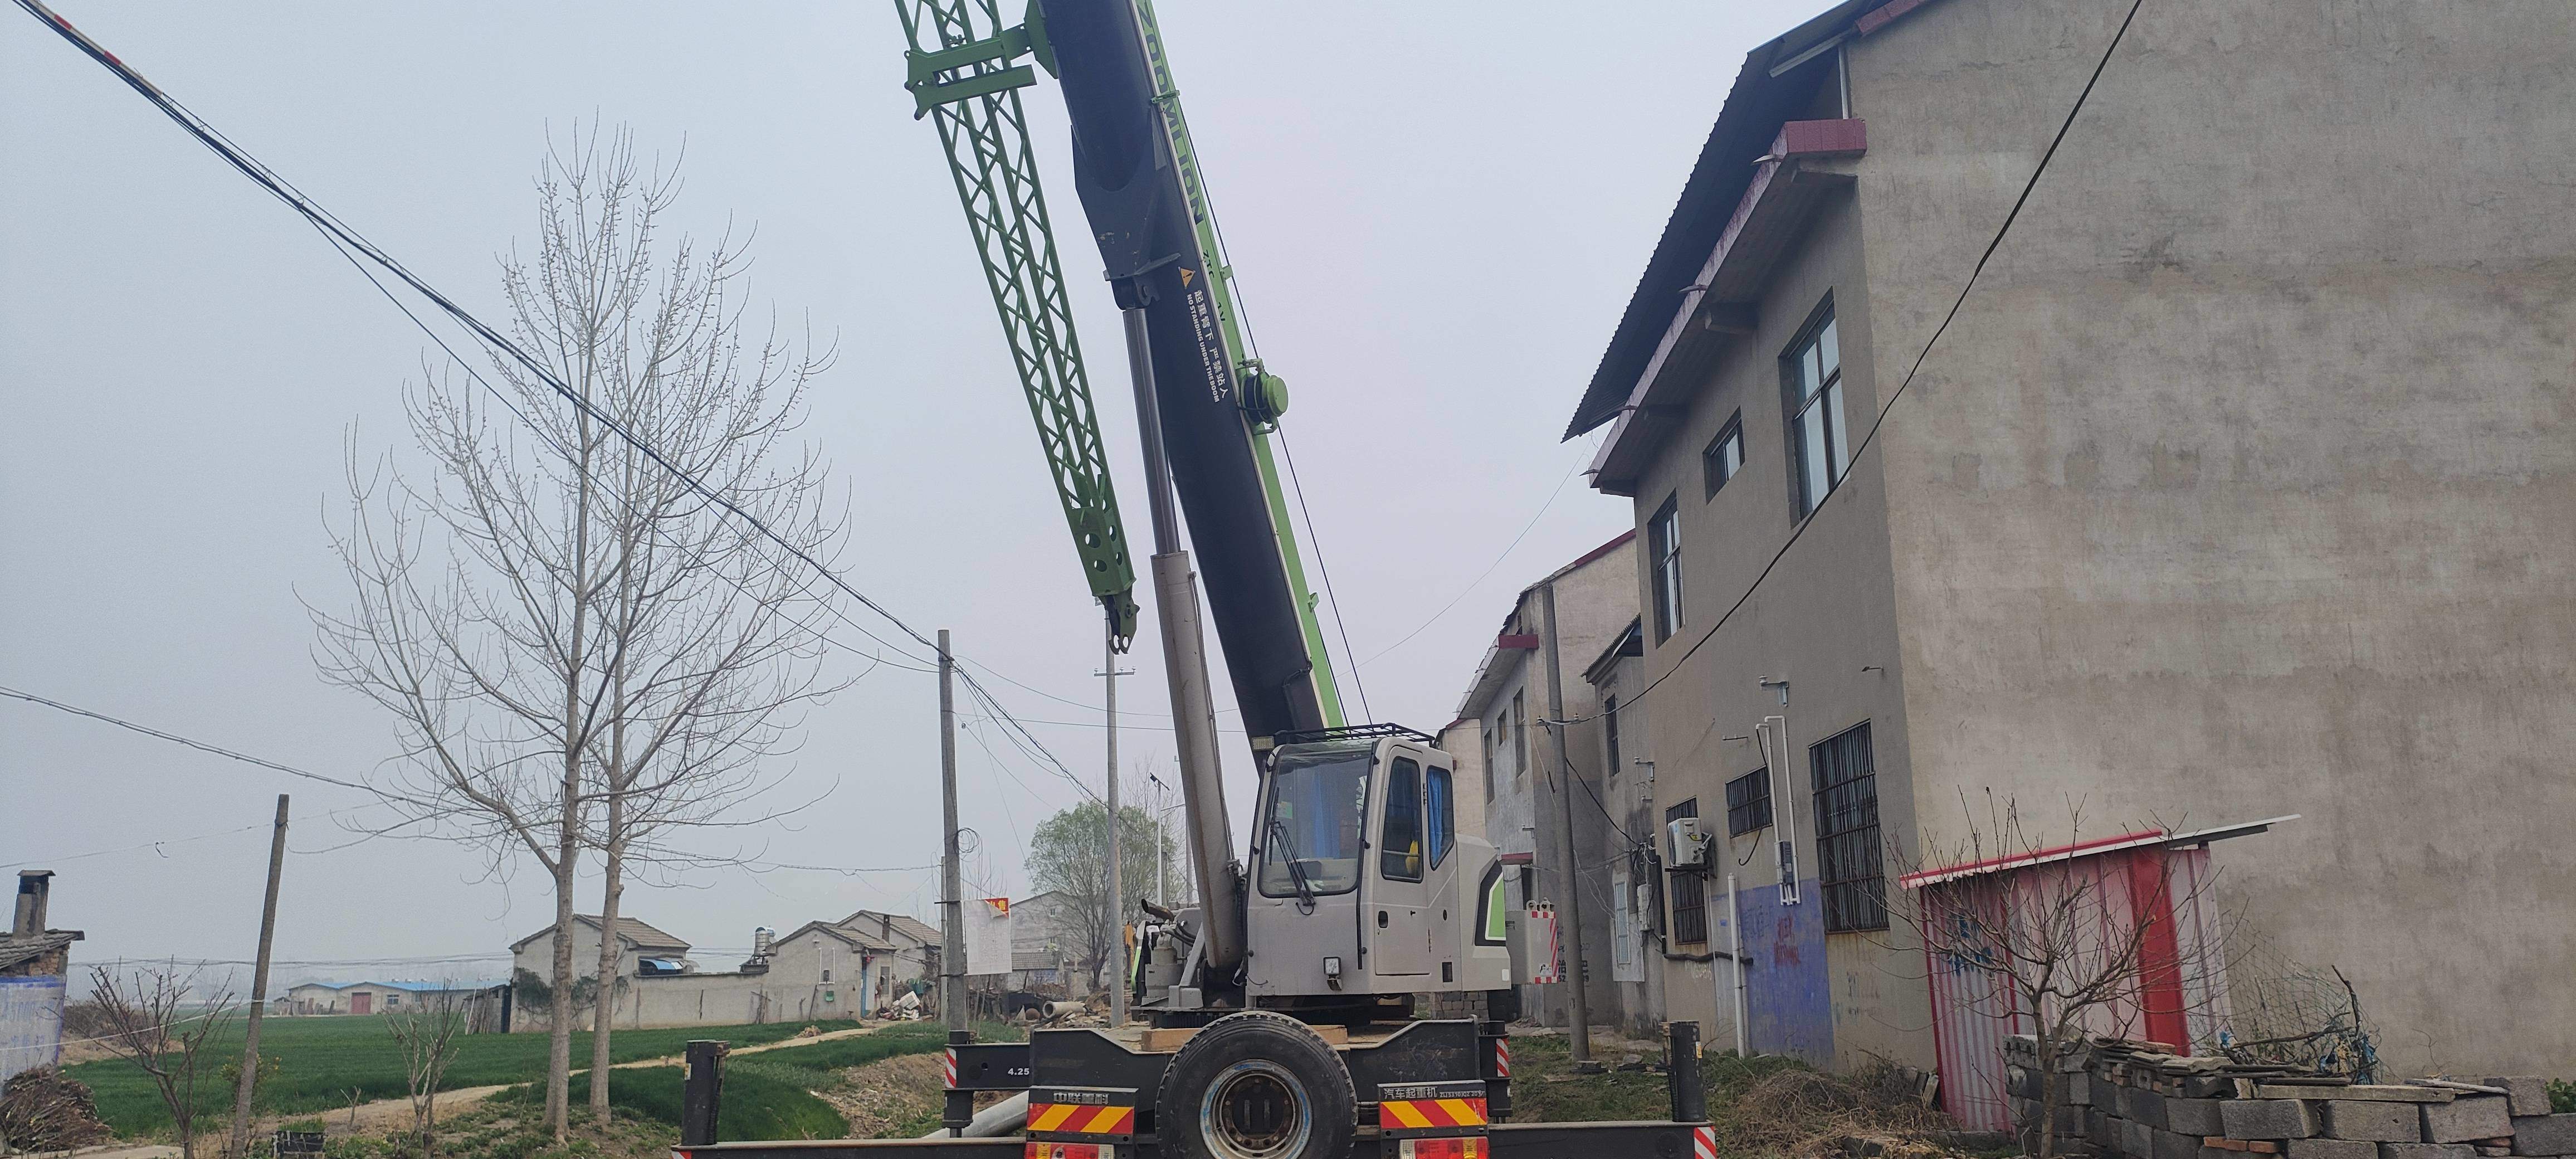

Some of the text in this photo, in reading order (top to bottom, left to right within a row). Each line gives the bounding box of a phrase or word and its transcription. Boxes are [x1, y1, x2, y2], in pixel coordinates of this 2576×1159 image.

[1137, 3, 1204, 225] ZOOMLION
[1187, 294, 1194, 305] NO
[1190, 305, 1204, 342] STANDING
[1194, 289, 1228, 398] 起重臂下 严禁站人
[1199, 342, 1210, 367] UNDER
[1210, 380, 1219, 402] BOOM
[1053, 1092, 1110, 1105] 中联重科
[1383, 1086, 1438, 1099] 汽车起重机
